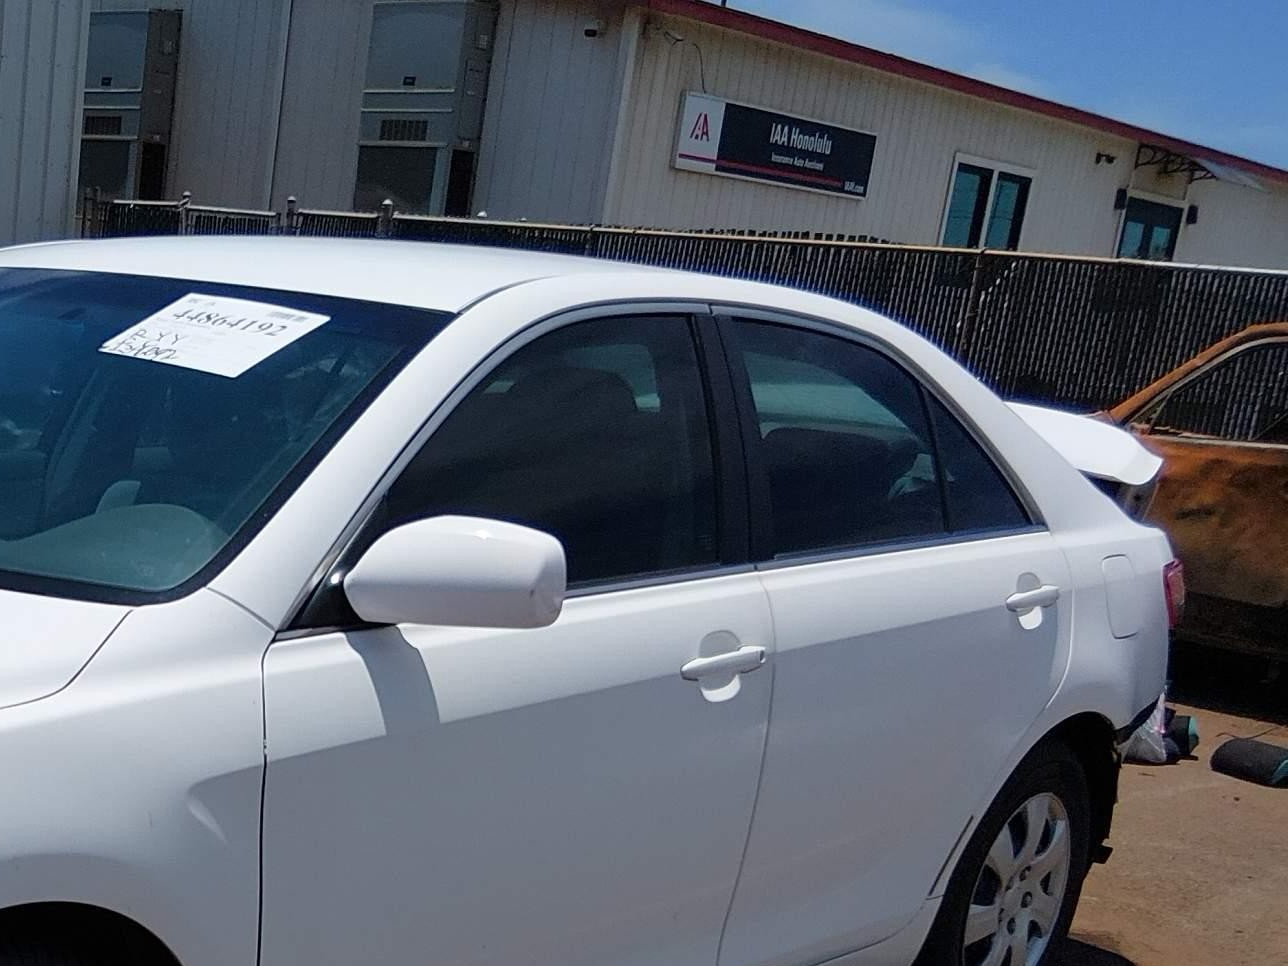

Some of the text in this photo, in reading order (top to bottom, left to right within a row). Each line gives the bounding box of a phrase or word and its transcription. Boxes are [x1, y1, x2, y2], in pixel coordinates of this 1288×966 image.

[769, 122, 833, 155] IAA Honolulu
[173, 308, 288, 337] 44864192
